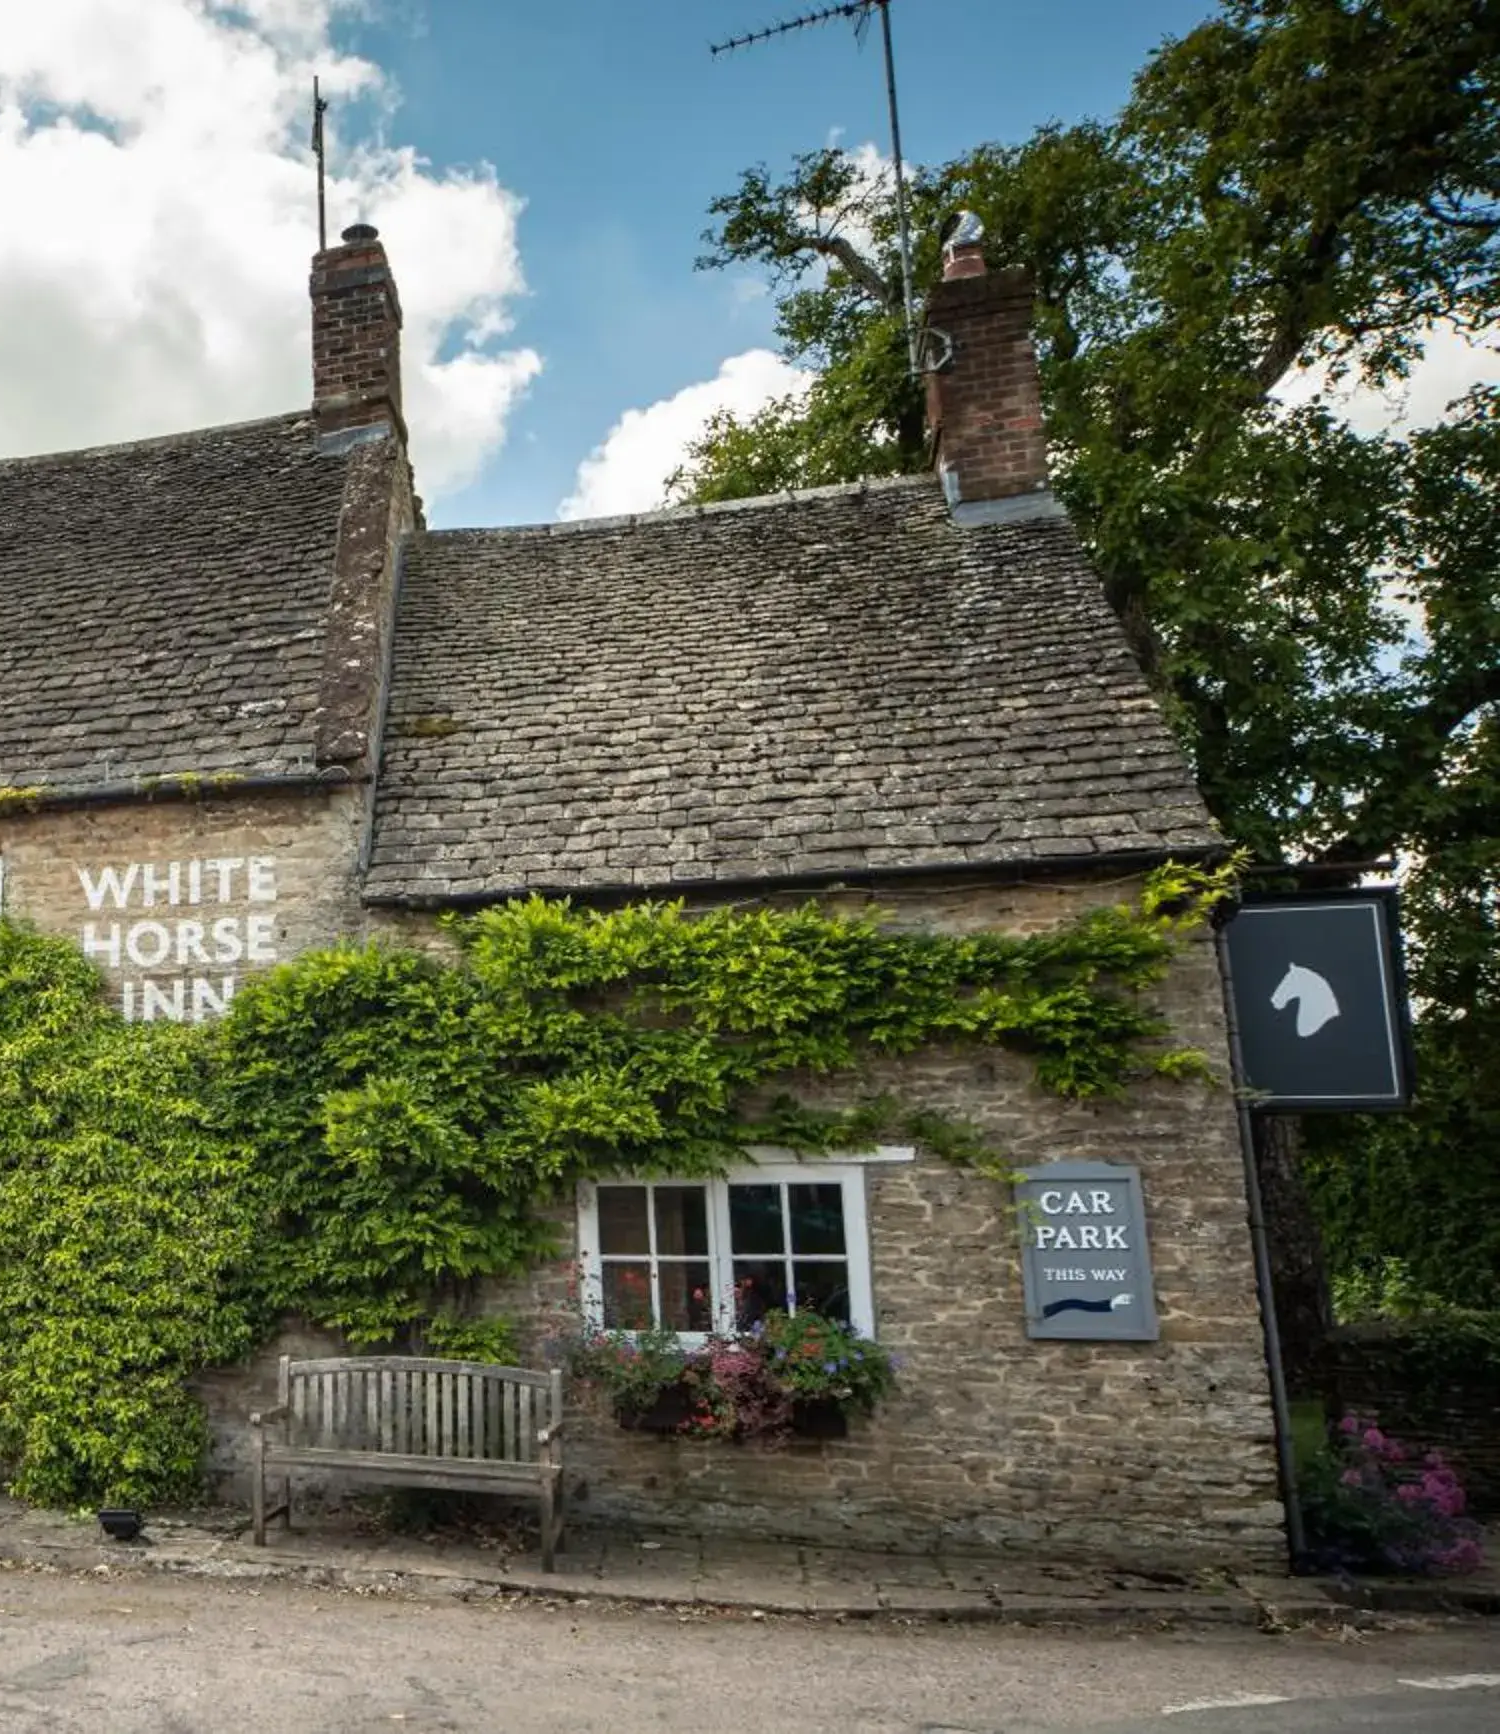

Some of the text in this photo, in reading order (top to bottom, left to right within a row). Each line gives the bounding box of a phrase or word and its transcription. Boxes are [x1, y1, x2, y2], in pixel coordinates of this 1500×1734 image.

[76, 855, 277, 911] WHITE
[82, 913, 277, 968] HORSE
[122, 974, 236, 1024] INN
[1040, 1190, 1116, 1215] CAR
[1035, 1225, 1130, 1250] PARK
[1043, 1267, 1127, 1282] THIS WAY
